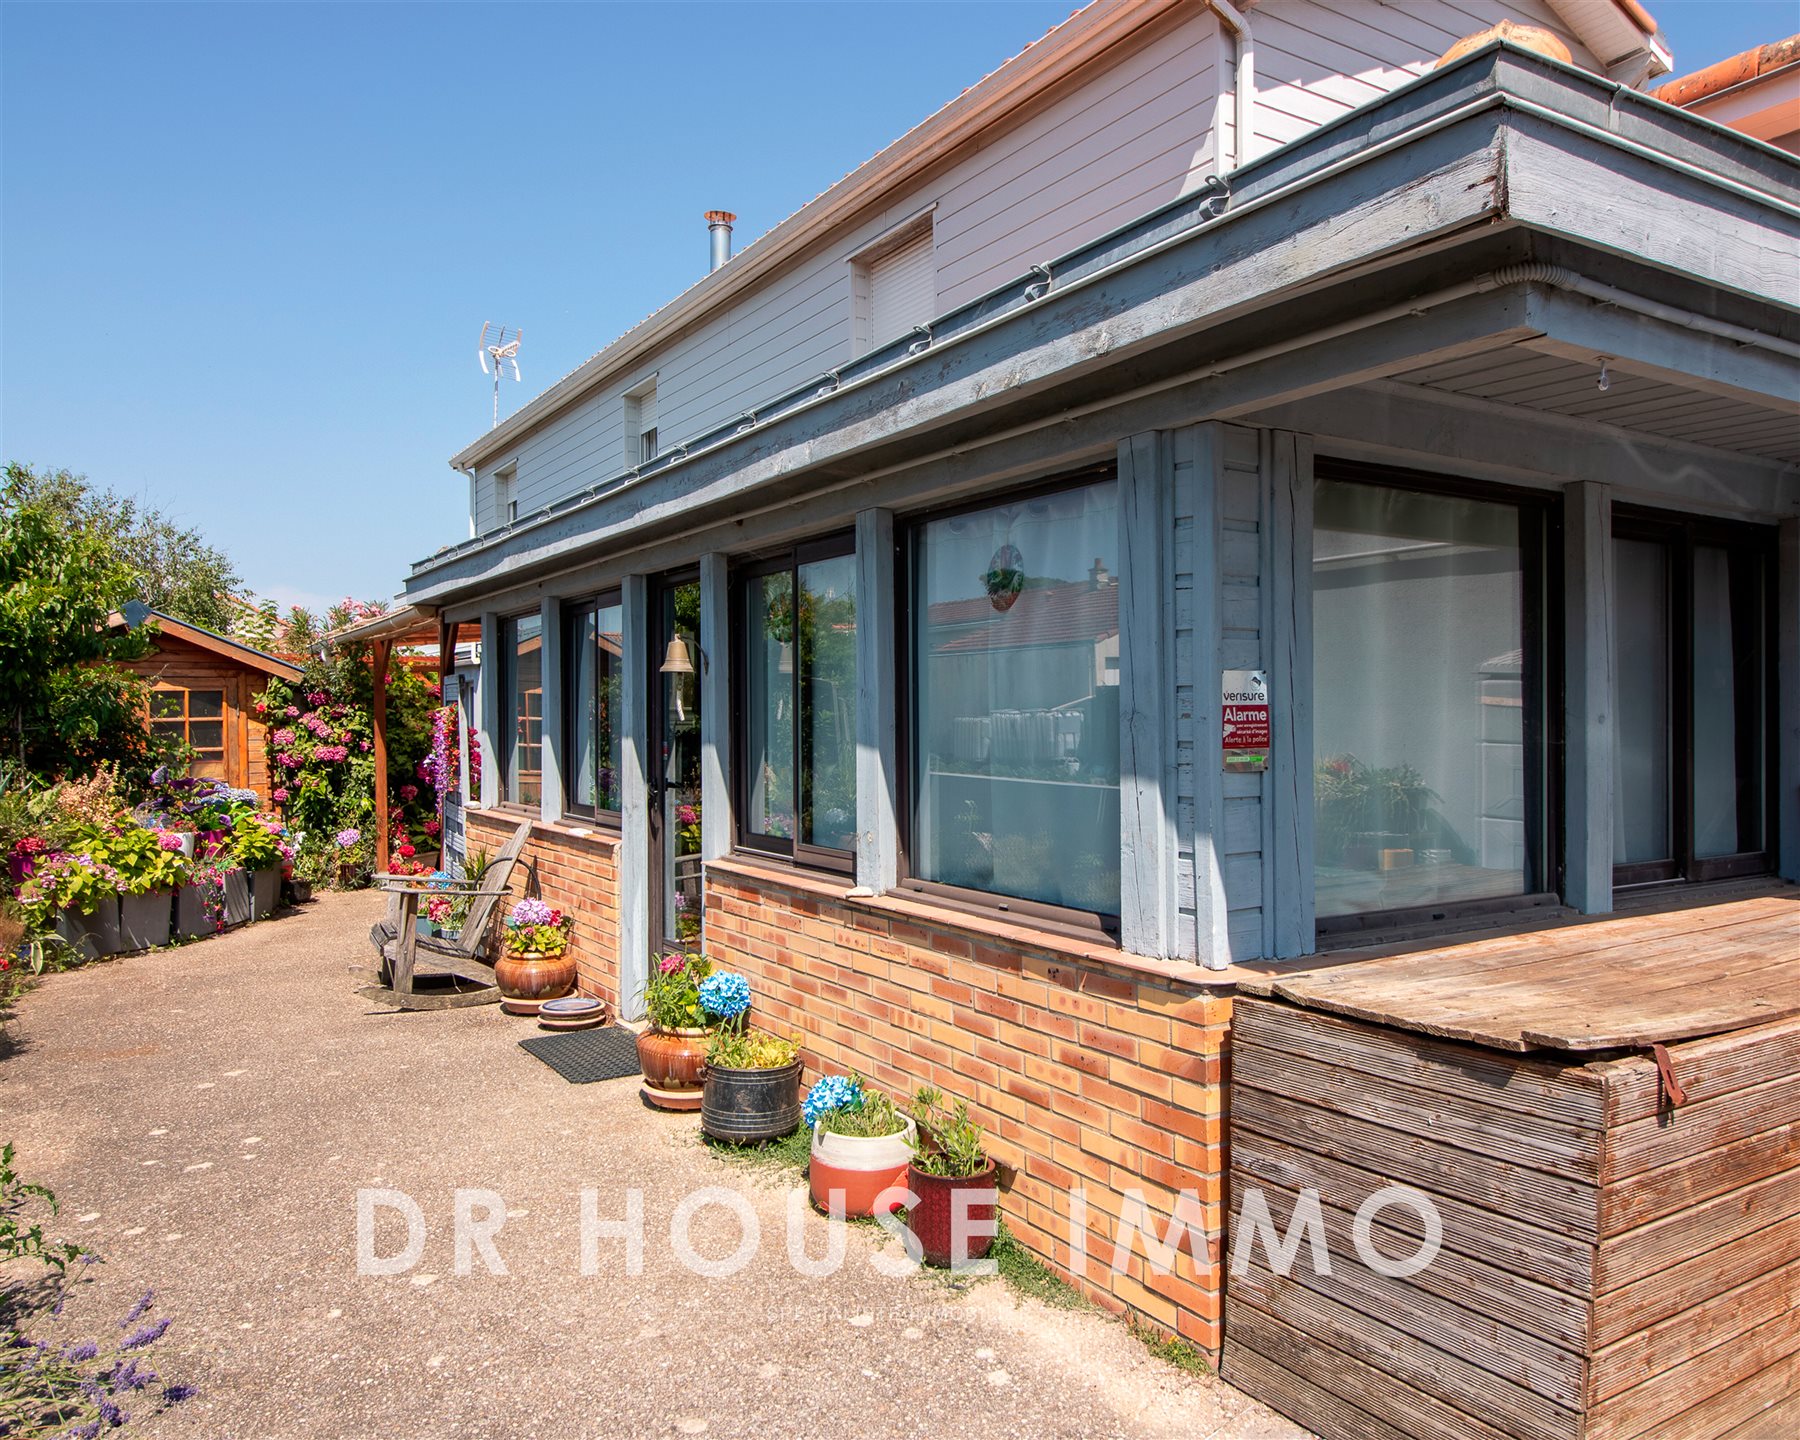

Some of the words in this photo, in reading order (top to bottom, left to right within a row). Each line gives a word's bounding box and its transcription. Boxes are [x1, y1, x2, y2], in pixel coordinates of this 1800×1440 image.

[1223, 691, 1265, 701] verisure
[1224, 708, 1267, 721] Alarme
[1252, 735, 1268, 744] police
